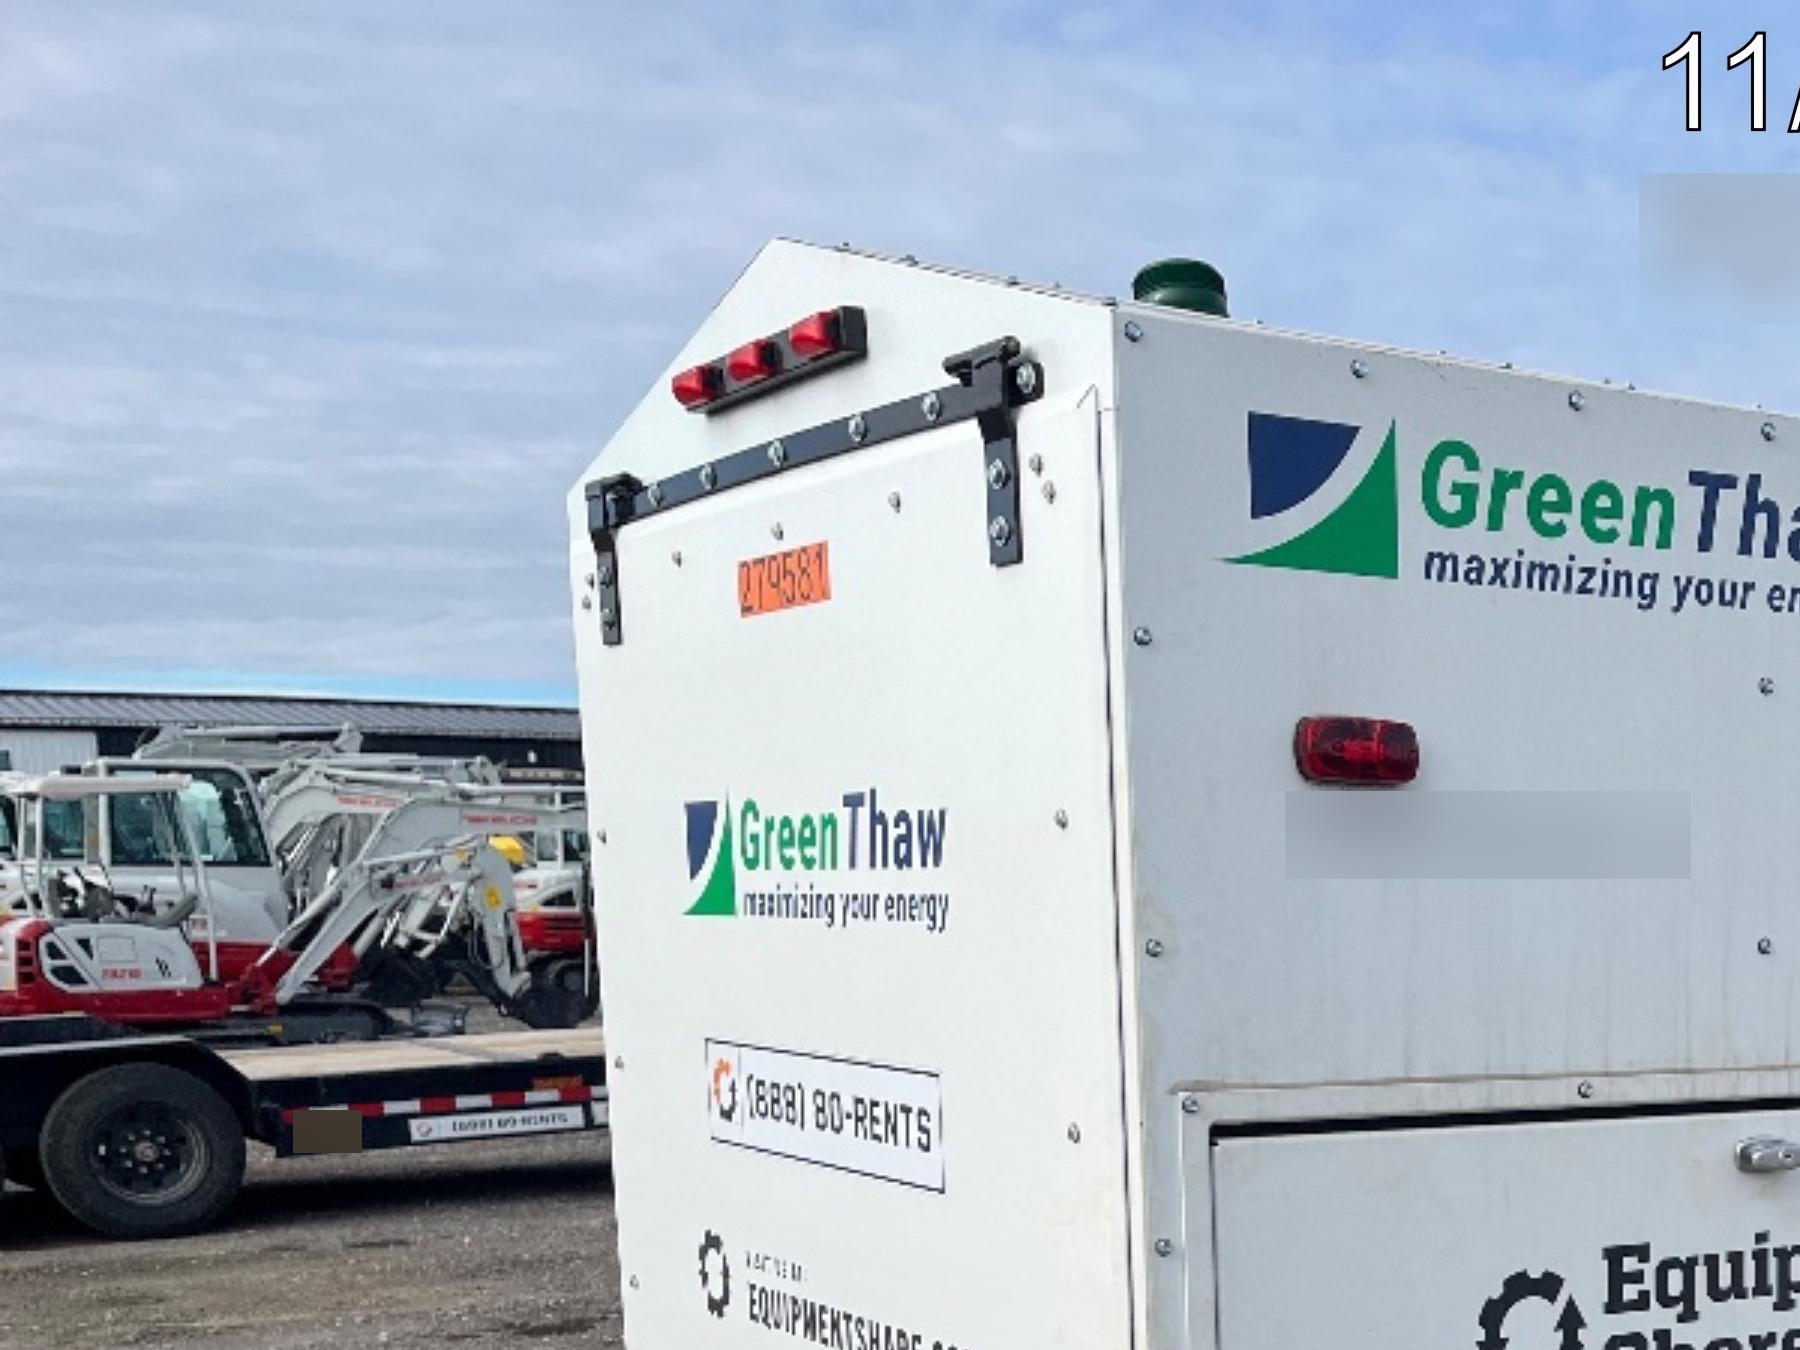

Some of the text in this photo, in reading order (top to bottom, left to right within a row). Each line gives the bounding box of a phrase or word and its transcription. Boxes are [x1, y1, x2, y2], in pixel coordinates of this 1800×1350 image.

[740, 551, 828, 615] 279581
[1424, 548, 1660, 609] maximizing
[1672, 572, 1756, 613] your
[743, 883, 950, 934] maximizing your energy
[747, 1074, 933, 1153] (888) 80-RENTS
